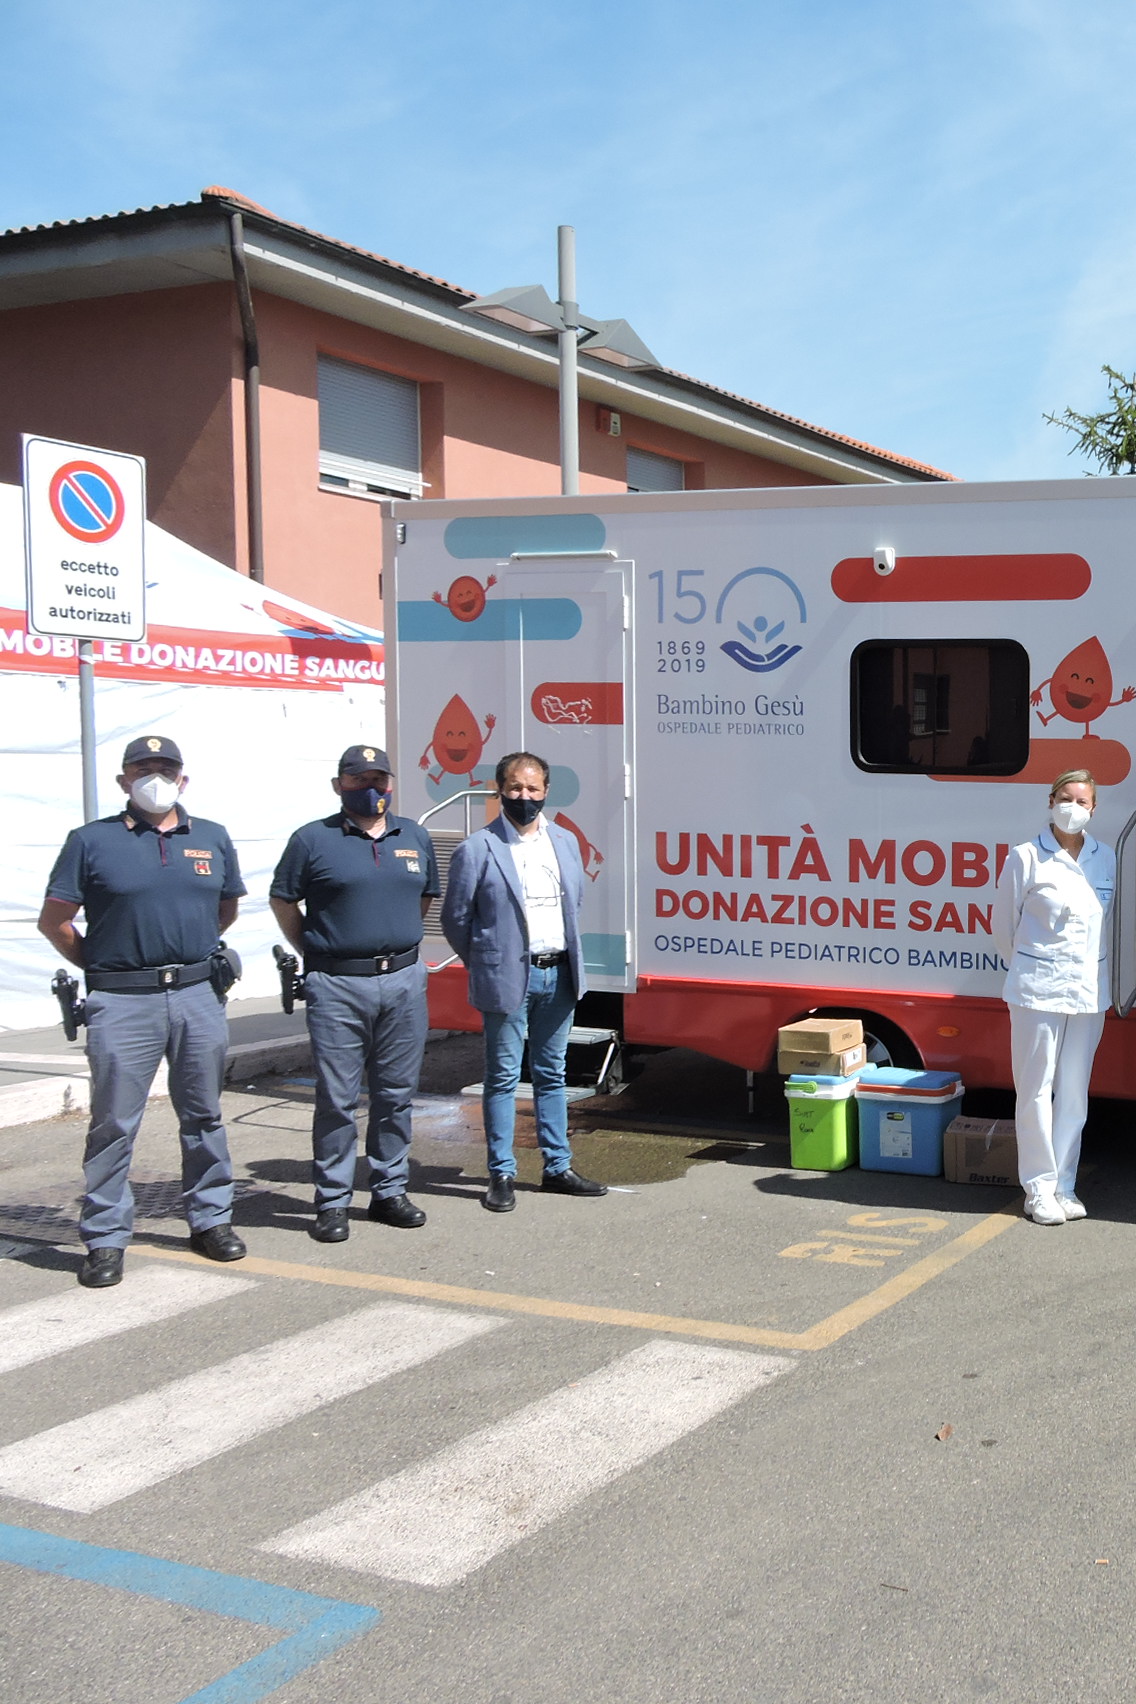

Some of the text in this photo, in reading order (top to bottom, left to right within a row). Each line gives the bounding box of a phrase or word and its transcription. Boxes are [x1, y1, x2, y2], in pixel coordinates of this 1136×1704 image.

[60, 559, 120, 577] eccetto
[65, 583, 116, 600] veicoli
[49, 606, 131, 625] autorizzati
[657, 641, 706, 655] 1869
[130, 643, 300, 676] DONAZIONE
[657, 658, 706, 673] 2019
[657, 694, 804, 717] Bambino Gesù
[657, 721, 804, 736] OSPEDALE PEDIATRICO
[656, 823, 832, 882] UNITÀ
[656, 889, 993, 935] DONAZIONE SAN
[655, 935, 763, 957] OSPEDALE
[770, 941, 900, 965] PEDIATRICO
[969, 1173, 1010, 1184] Baxter
